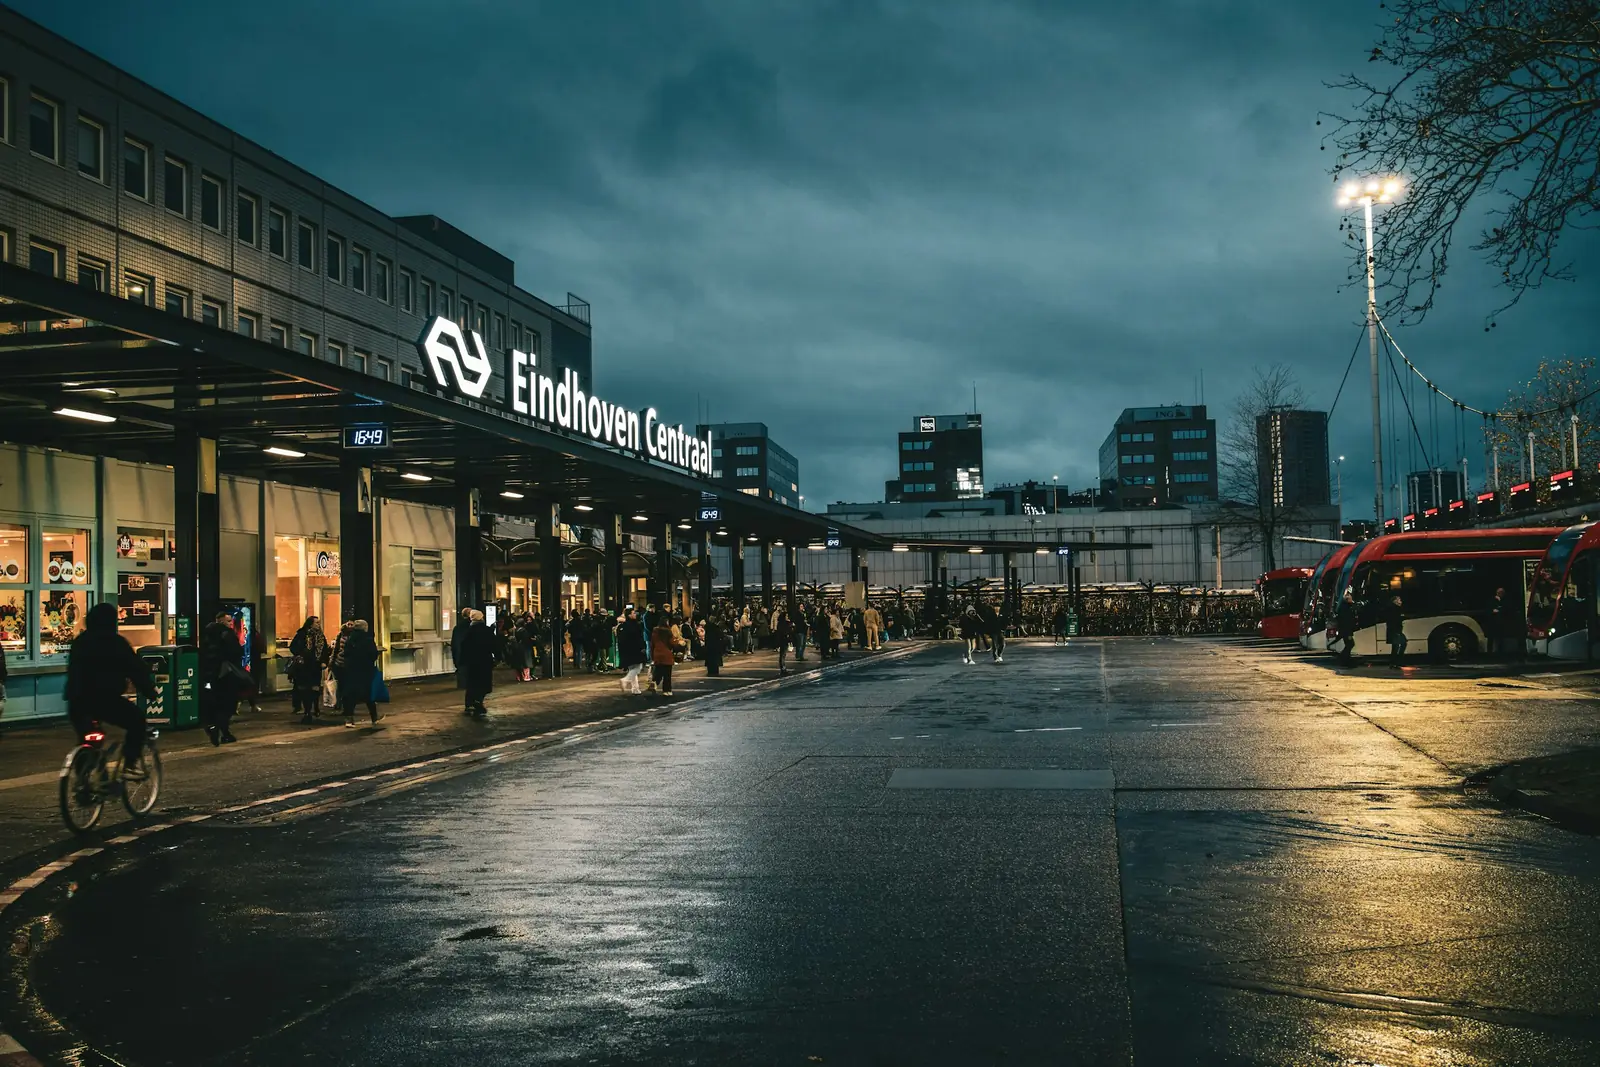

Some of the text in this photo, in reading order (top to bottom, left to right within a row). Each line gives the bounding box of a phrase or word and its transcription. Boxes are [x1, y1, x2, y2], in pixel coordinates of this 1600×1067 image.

[512, 349, 713, 476] Eindhoven Centraal
[354, 429, 383, 445] 16:49
[361, 481, 370, 501] A
[472, 499, 478, 516] B
